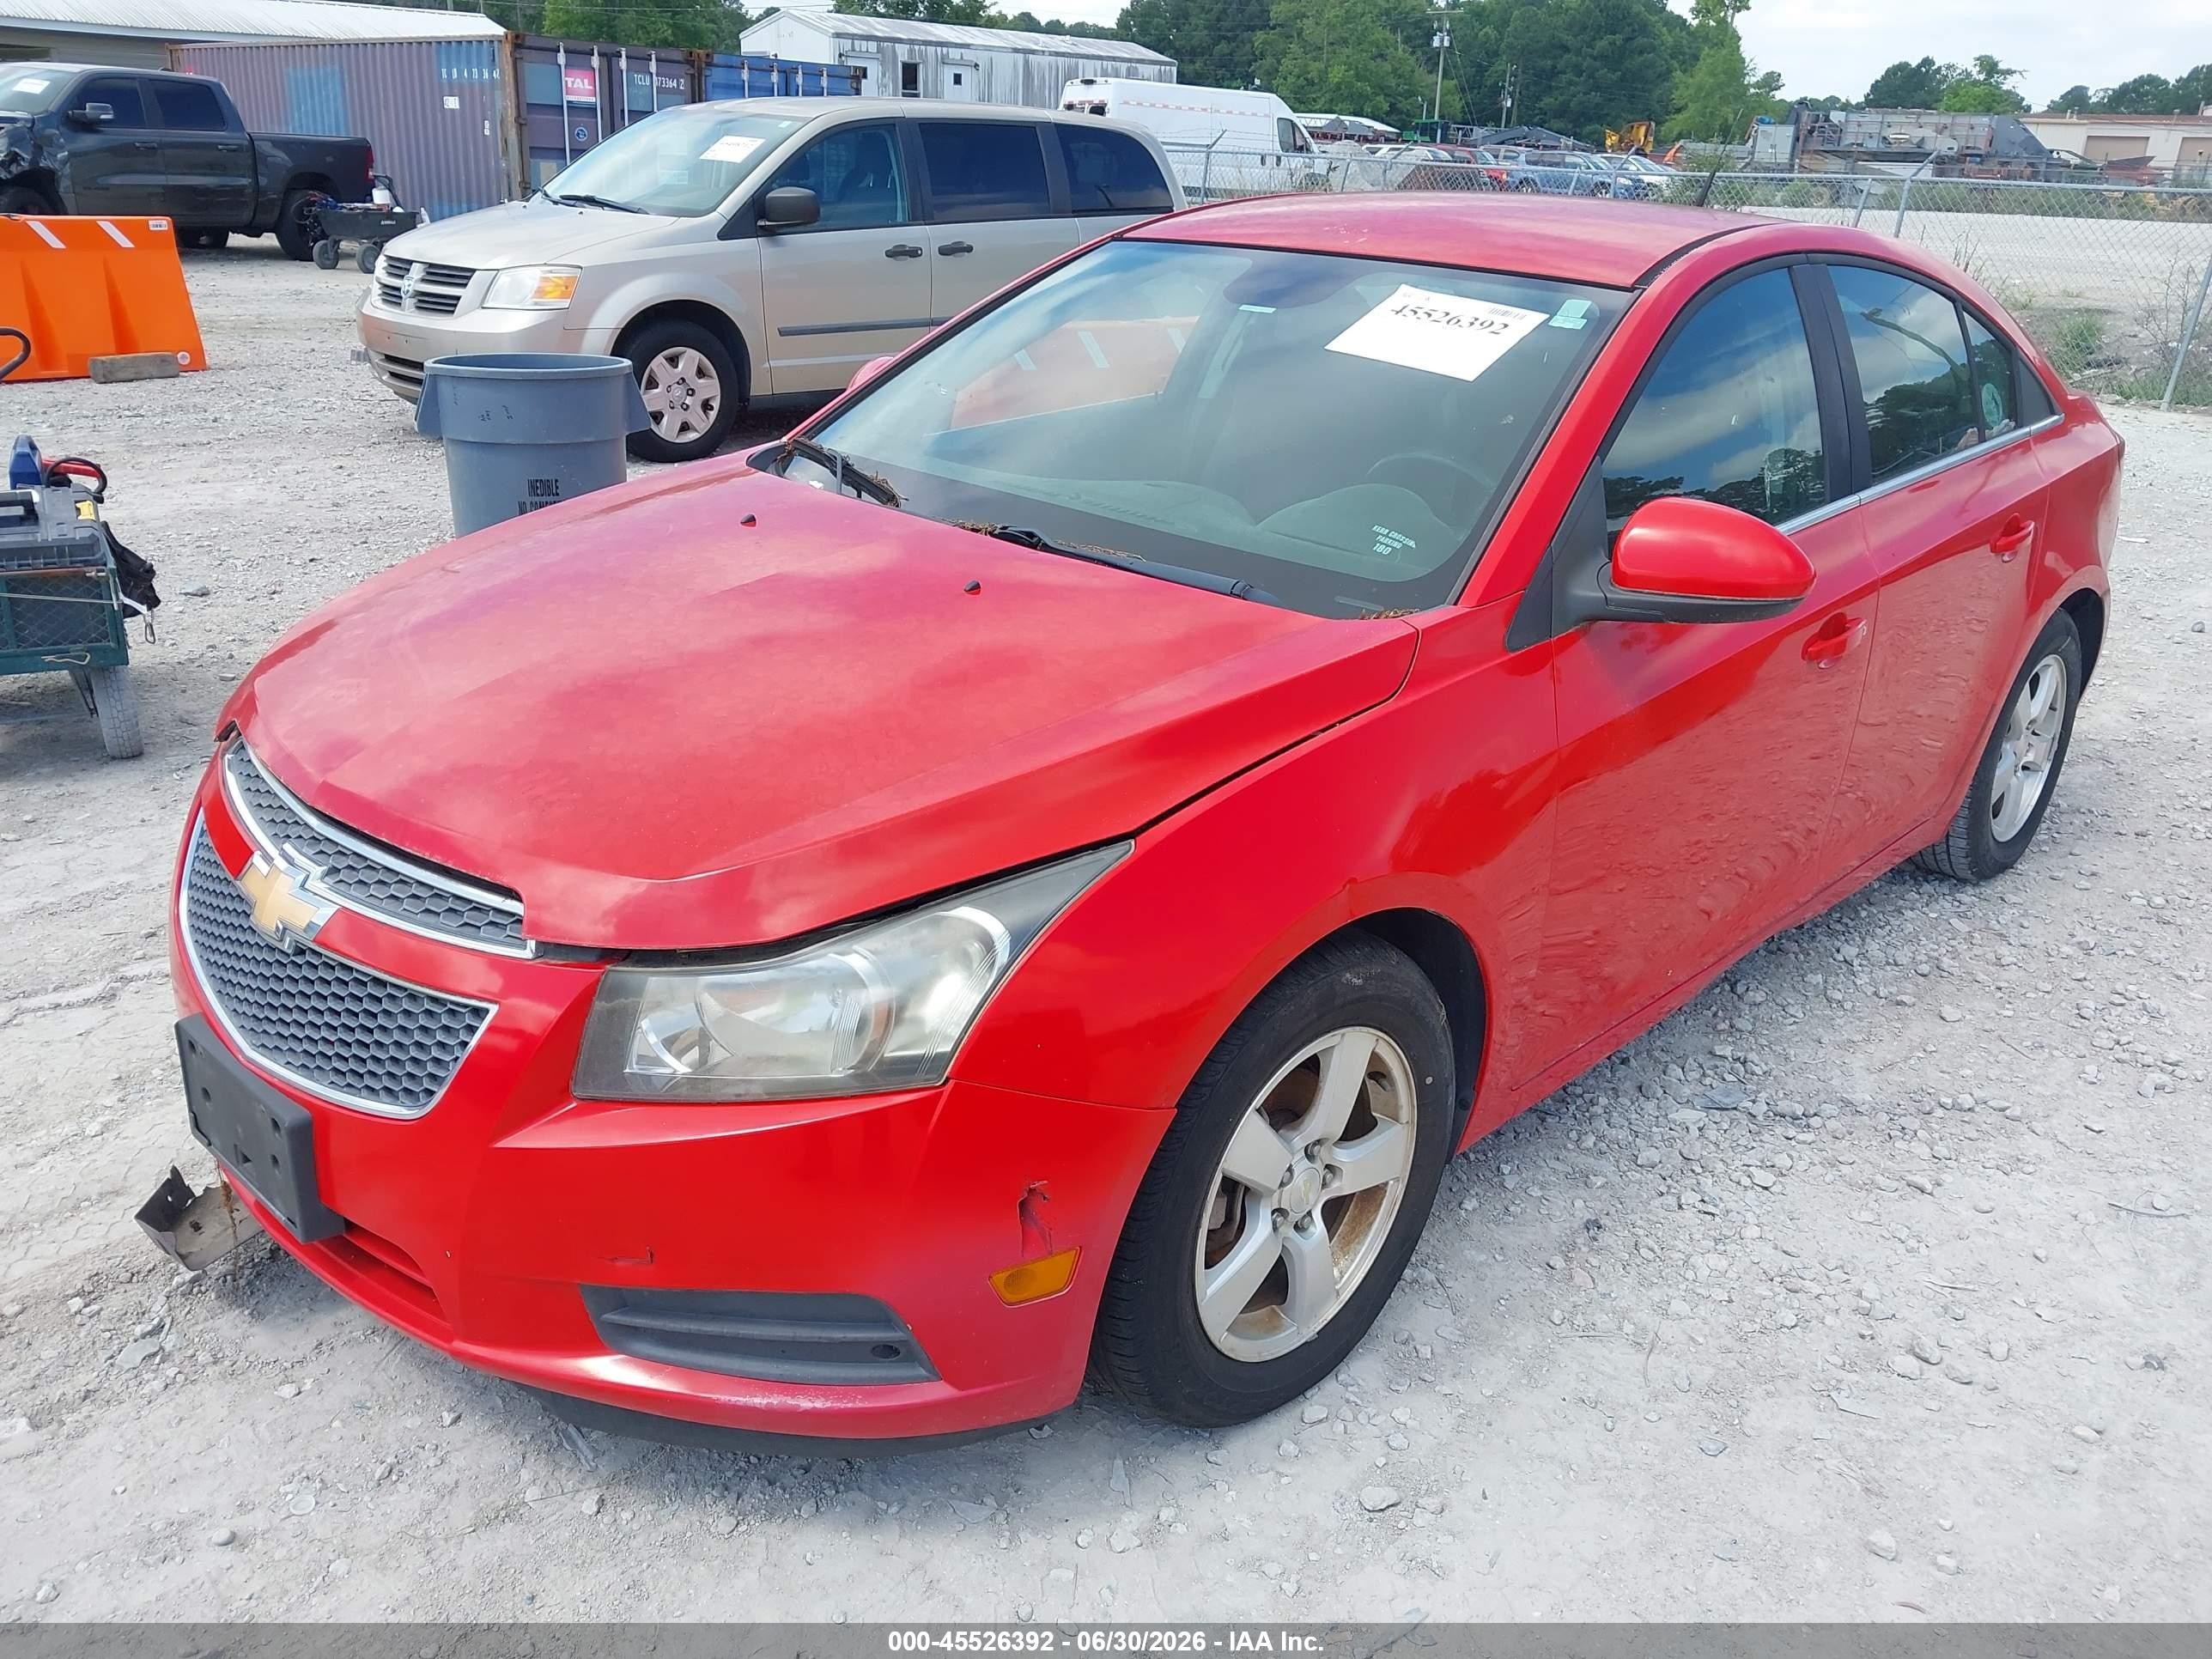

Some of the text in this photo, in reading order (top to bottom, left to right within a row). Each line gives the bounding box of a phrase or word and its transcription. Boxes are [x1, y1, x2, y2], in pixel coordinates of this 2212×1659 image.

[564, 77, 593, 89] TAL
[634, 74, 650, 86] TCLU
[1389, 303, 1510, 336] 45526392
[527, 478, 560, 497] INEDIBLE
[1372, 543, 1393, 555] 180
[1376, 534, 1403, 550] PARKING
